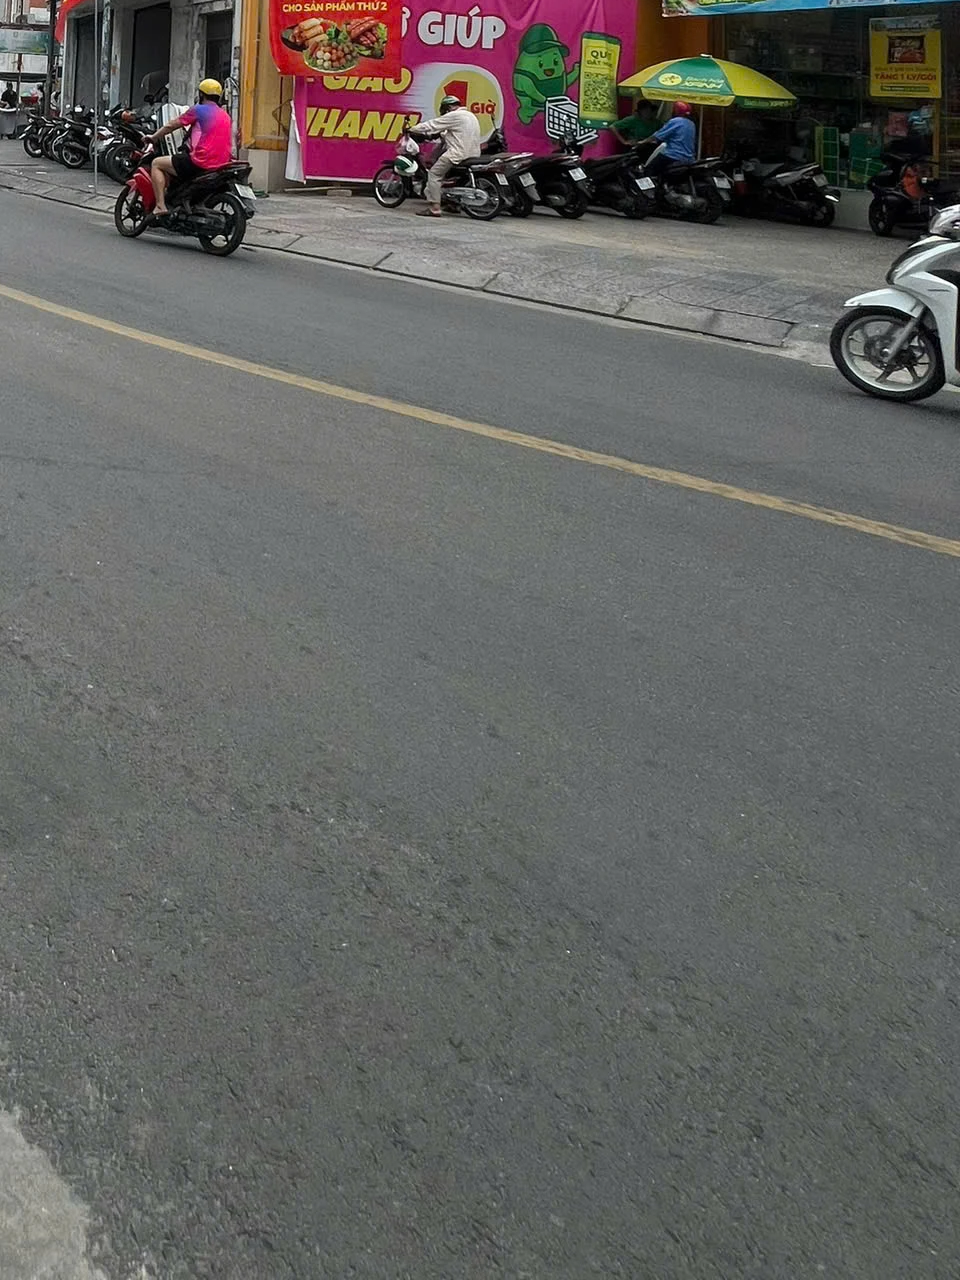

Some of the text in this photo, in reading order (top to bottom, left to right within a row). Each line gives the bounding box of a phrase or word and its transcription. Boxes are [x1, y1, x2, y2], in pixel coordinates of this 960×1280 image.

[282, 0, 387, 12] CHO SẢN PHẨM THỨ 2
[418, 6, 506, 49] GIÚP
[471, 99, 497, 114] GIỜ
